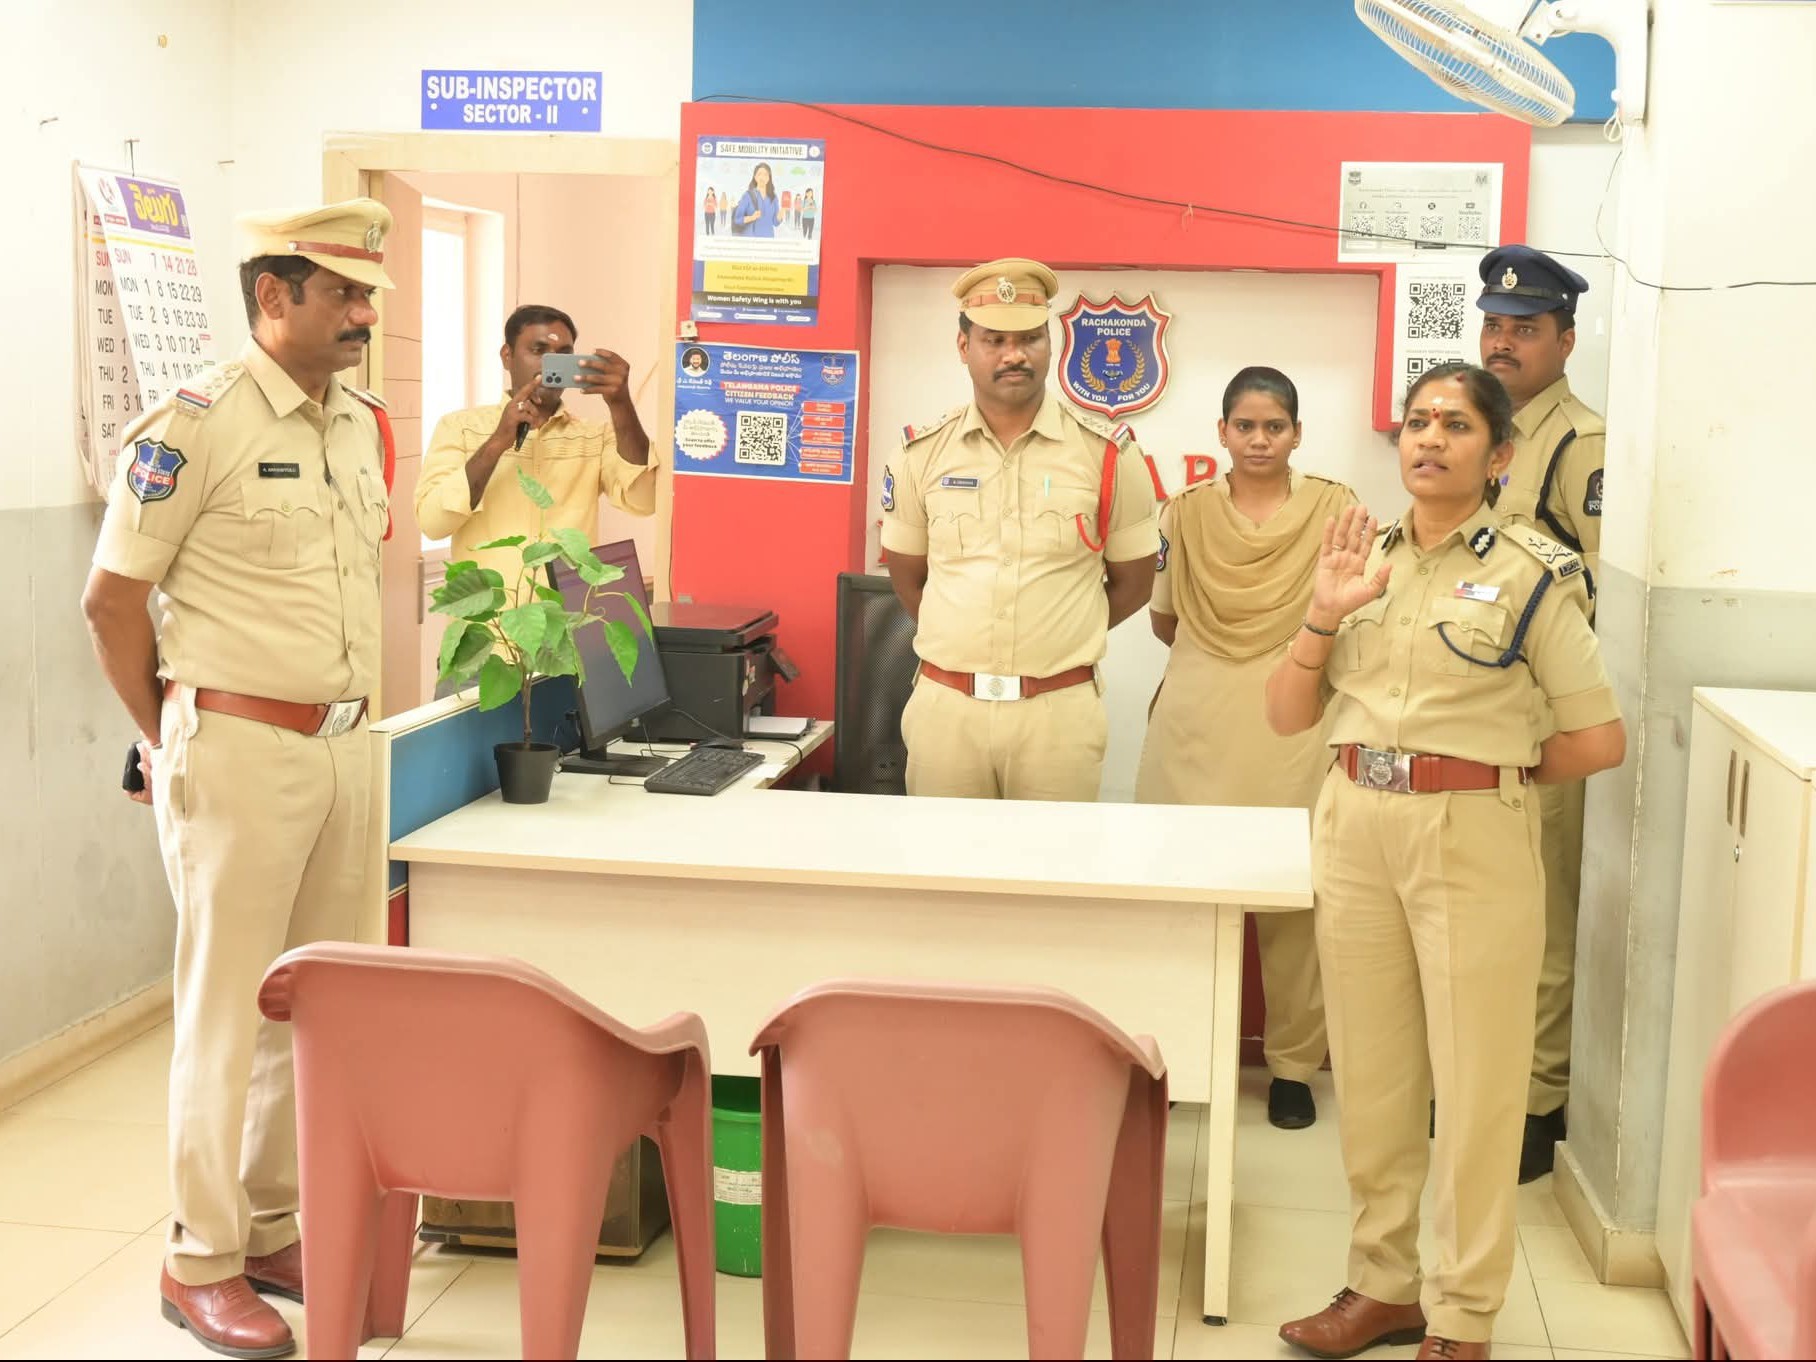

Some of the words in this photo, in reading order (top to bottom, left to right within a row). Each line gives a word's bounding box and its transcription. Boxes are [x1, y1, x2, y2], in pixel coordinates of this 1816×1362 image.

[427, 76, 597, 101] SUB-INSPECTOR
[463, 104, 532, 124] SECTOR
[546, 105, 558, 124] II
[720, 144, 736, 153] SAFE
[738, 145, 769, 154] MOBILITY
[770, 146, 803, 156] INITIATIVE
[114, 247, 132, 264] SUN
[150, 252, 157, 270] 7
[162, 255, 173, 272] 14
[175, 256, 185, 274] 21
[186, 258, 197, 276] 28
[95, 280, 113, 297] MON
[120, 276, 139, 293] MON
[144, 278, 151, 297] 1
[157, 280, 164, 297] 8
[167, 281, 179, 300] 15
[179, 283, 191, 301] 22
[190, 285, 202, 303] 29
[732, 296, 751, 304] Safety
[752, 296, 768, 305] Wing
[775, 297, 789, 305] with
[97, 308, 113, 325] TUE
[128, 304, 144, 321] TUE
[150, 306, 157, 323] 2
[162, 307, 170, 325] 9
[173, 309, 184, 326] 16
[184, 310, 196, 327] 23
[196, 312, 208, 329] 30
[1081, 318, 1147, 327] RACHAKONDA
[1097, 328, 1131, 336] POLICE
[97, 337, 115, 353] WED
[121, 339, 127, 355] 1
[132, 333, 150, 349] WED
[154, 334, 162, 351] 3
[166, 335, 177, 352] 10
[178, 336, 187, 353] 17
[189, 337, 201, 355] 24
[723, 350, 768, 363] తెలంగాణ
[770, 351, 800, 365] పోలీస్
[99, 365, 114, 382] THU
[122, 366, 128, 383] 2
[140, 361, 155, 377] THU
[161, 361, 168, 378] 4
[173, 363, 181, 380] 11
[725, 390, 754, 398] CITIZEN
[755, 391, 794, 400] FEEDBACK
[770, 384, 797, 393] POLICE
[1073, 381, 1091, 398] WITH
[1091, 394, 1107, 402] YOU
[1135, 383, 1150, 396] YOU
[102, 394, 115, 410] FRI
[123, 394, 130, 412] 3
[101, 423, 116, 439] SAT
[135, 466, 171, 486] POLICE
